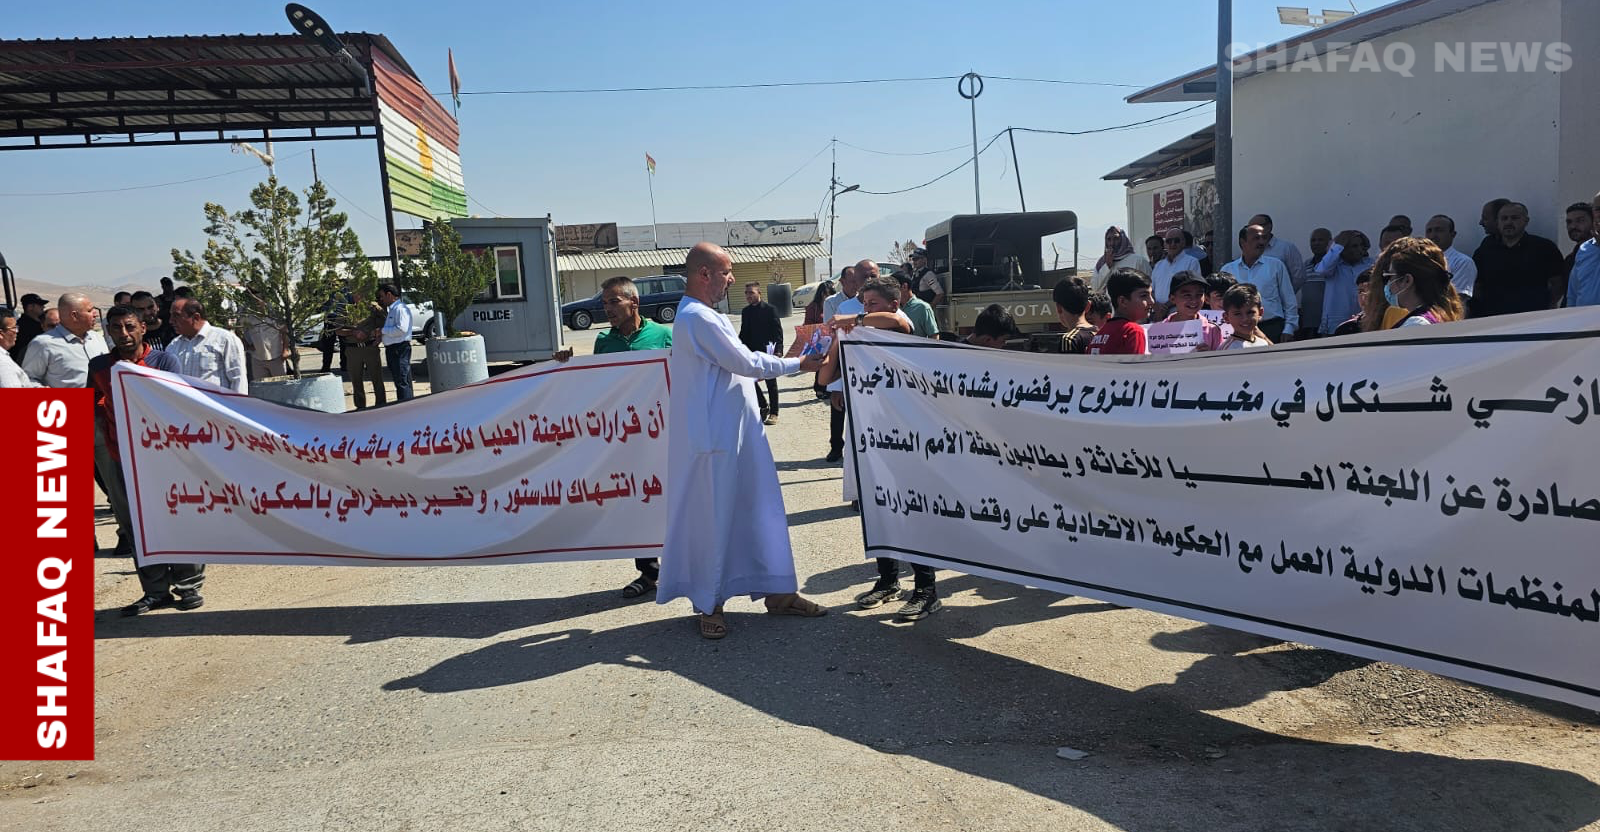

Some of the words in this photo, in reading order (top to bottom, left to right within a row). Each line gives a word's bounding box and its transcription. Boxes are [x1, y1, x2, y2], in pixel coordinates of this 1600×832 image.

[473, 309, 511, 321] POLICE
[974, 303, 1052, 317] TYOTA
[433, 350, 477, 364] POLICE
[849, 363, 900, 394] الأخيرة
[902, 367, 955, 399] القرارات
[958, 370, 998, 408] بشدة
[1002, 375, 1074, 414] يرفضون
[1080, 380, 1145, 414] النزوح
[1151, 380, 1264, 421] مخيمات
[1270, 378, 1306, 427] في
[1315, 375, 1452, 422] شنكال
[1467, 374, 1600, 429] ازحي
[140, 417, 220, 451] المهجرين
[529, 414, 582, 447] اللجنة
[587, 405, 642, 443] قرارات
[648, 400, 665, 438] أن
[281, 433, 328, 463] وزيرة
[411, 422, 474, 456] للأغاثة
[478, 420, 526, 455] العليا
[867, 426, 920, 453] المتحدة
[924, 428, 963, 462] الأمم
[966, 430, 1003, 466] بعثة
[1004, 441, 1073, 477] يطالبون
[1084, 445, 1162, 478] للأغاثة
[1168, 459, 1336, 491] العليا
[166, 481, 245, 516] الايزيدي
[250, 481, 332, 519] بالمكون
[423, 485, 474, 516] تغير
[503, 479, 562, 513] للدستور
[567, 472, 636, 506] انتهاك
[641, 472, 662, 503] هو
[875, 485, 929, 516] القرارات
[1339, 461, 1430, 507] اللجنة
[1440, 475, 1486, 517] عن
[336, 484, 418, 522] ديمغرافي
[933, 494, 965, 519] هذه
[969, 497, 1011, 531] وقف
[1017, 504, 1050, 533] على
[1054, 504, 1144, 543] الاتحادية
[1145, 517, 1230, 557] الحكومة
[1238, 538, 1263, 573] مع
[1271, 540, 1333, 576] العمل
[1341, 546, 1446, 595] الدولية
